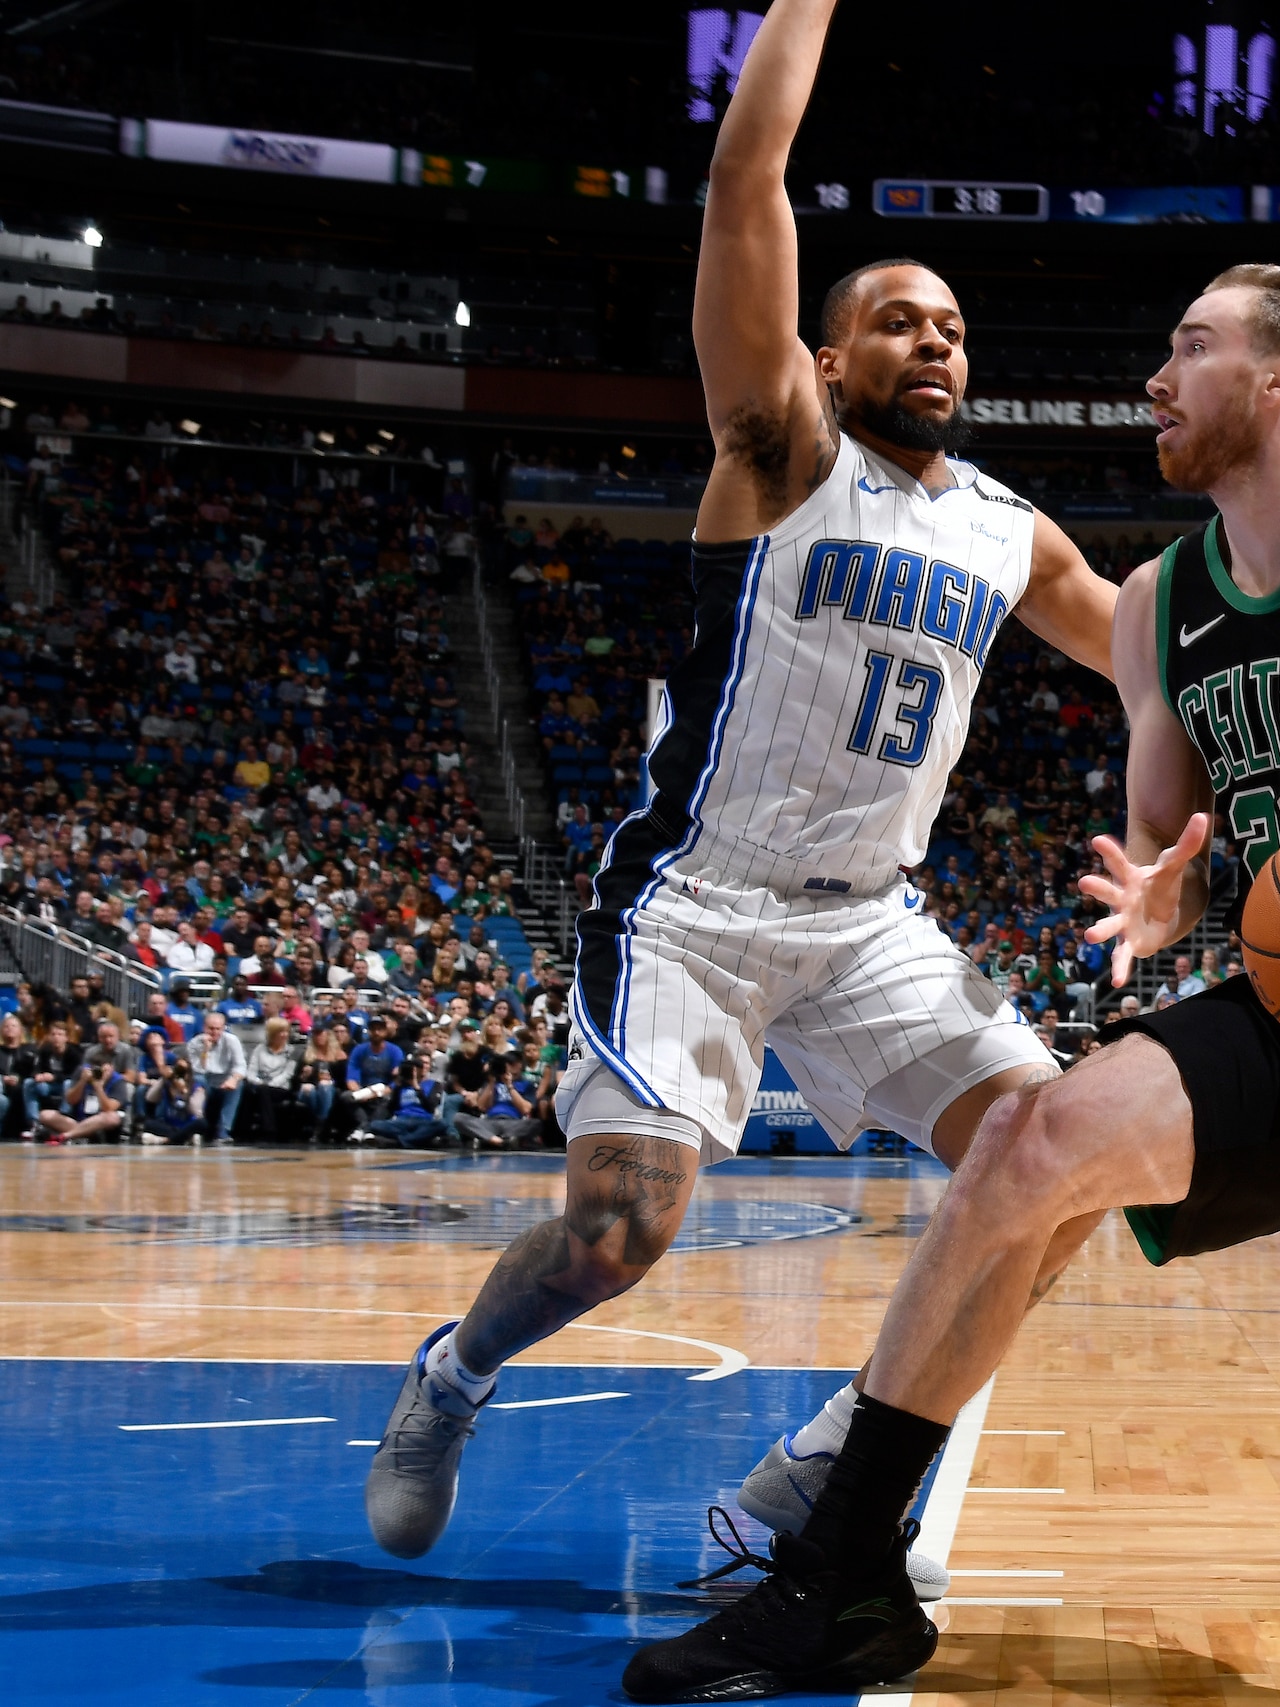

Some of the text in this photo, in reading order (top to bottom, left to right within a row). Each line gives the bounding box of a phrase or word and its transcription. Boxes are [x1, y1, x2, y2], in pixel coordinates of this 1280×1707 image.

[846, 648, 945, 768] 13
[765, 1113, 814, 1128] CENTER
[587, 1145, 688, 1185] Forever
